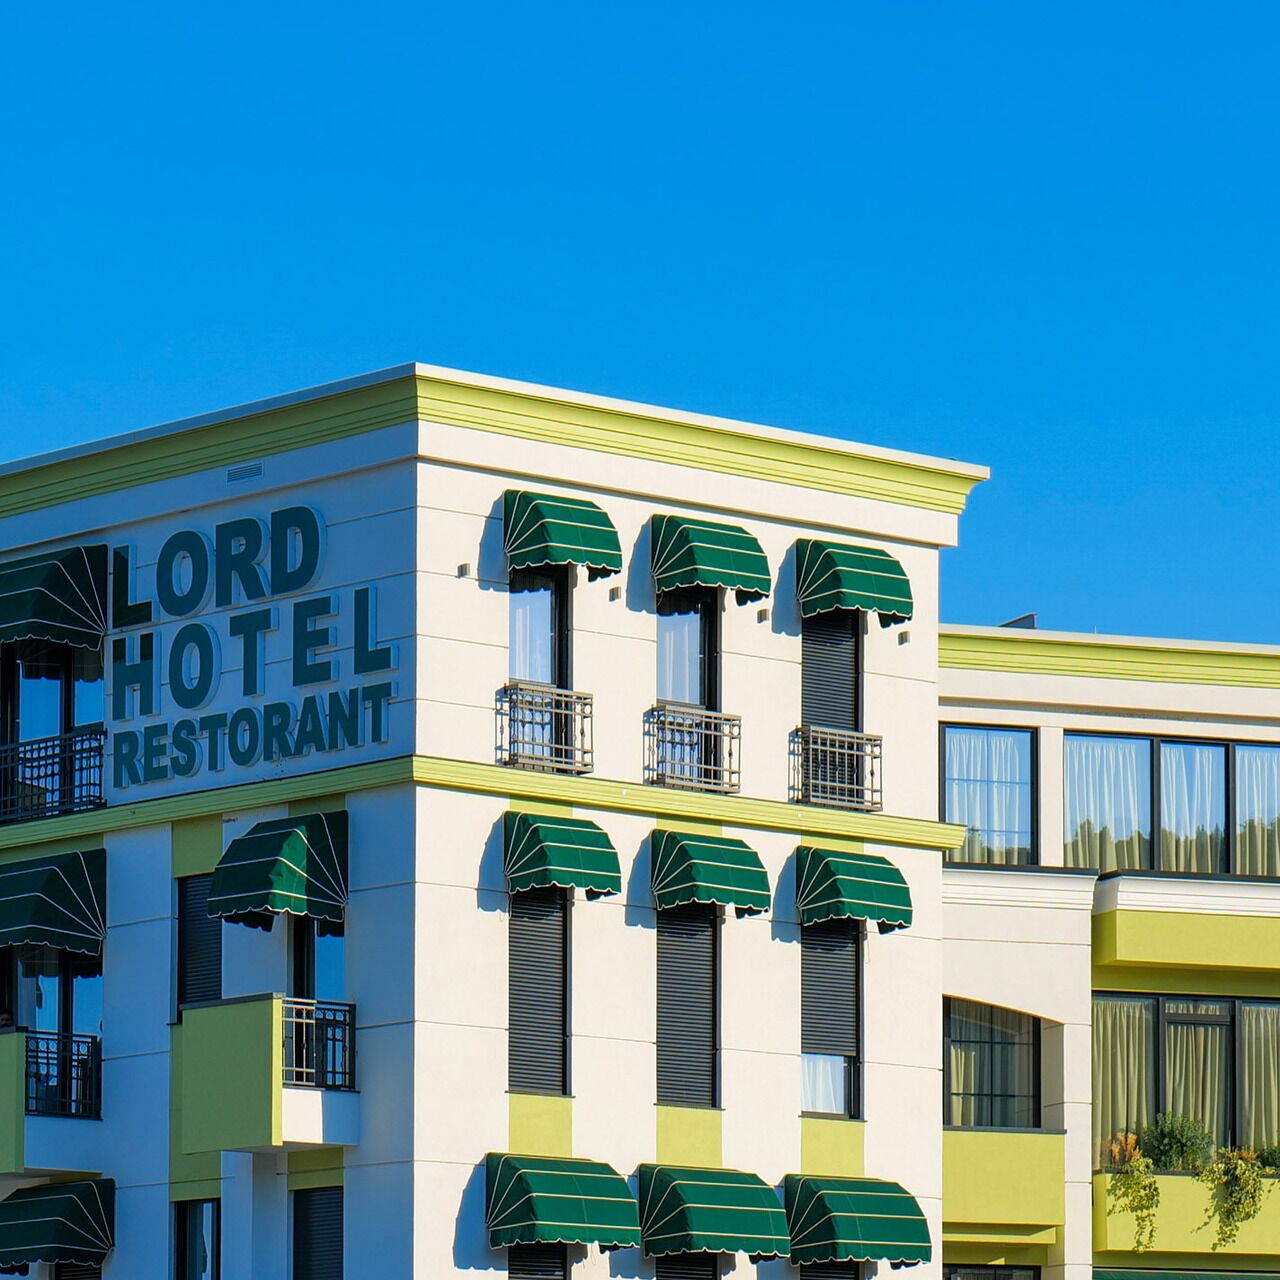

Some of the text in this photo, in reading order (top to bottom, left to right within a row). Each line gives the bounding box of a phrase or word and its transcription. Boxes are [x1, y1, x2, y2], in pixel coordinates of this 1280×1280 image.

[112, 506, 325, 629] LORD
[111, 586, 397, 721] HOTEL
[113, 681, 396, 788] RESTORANT
